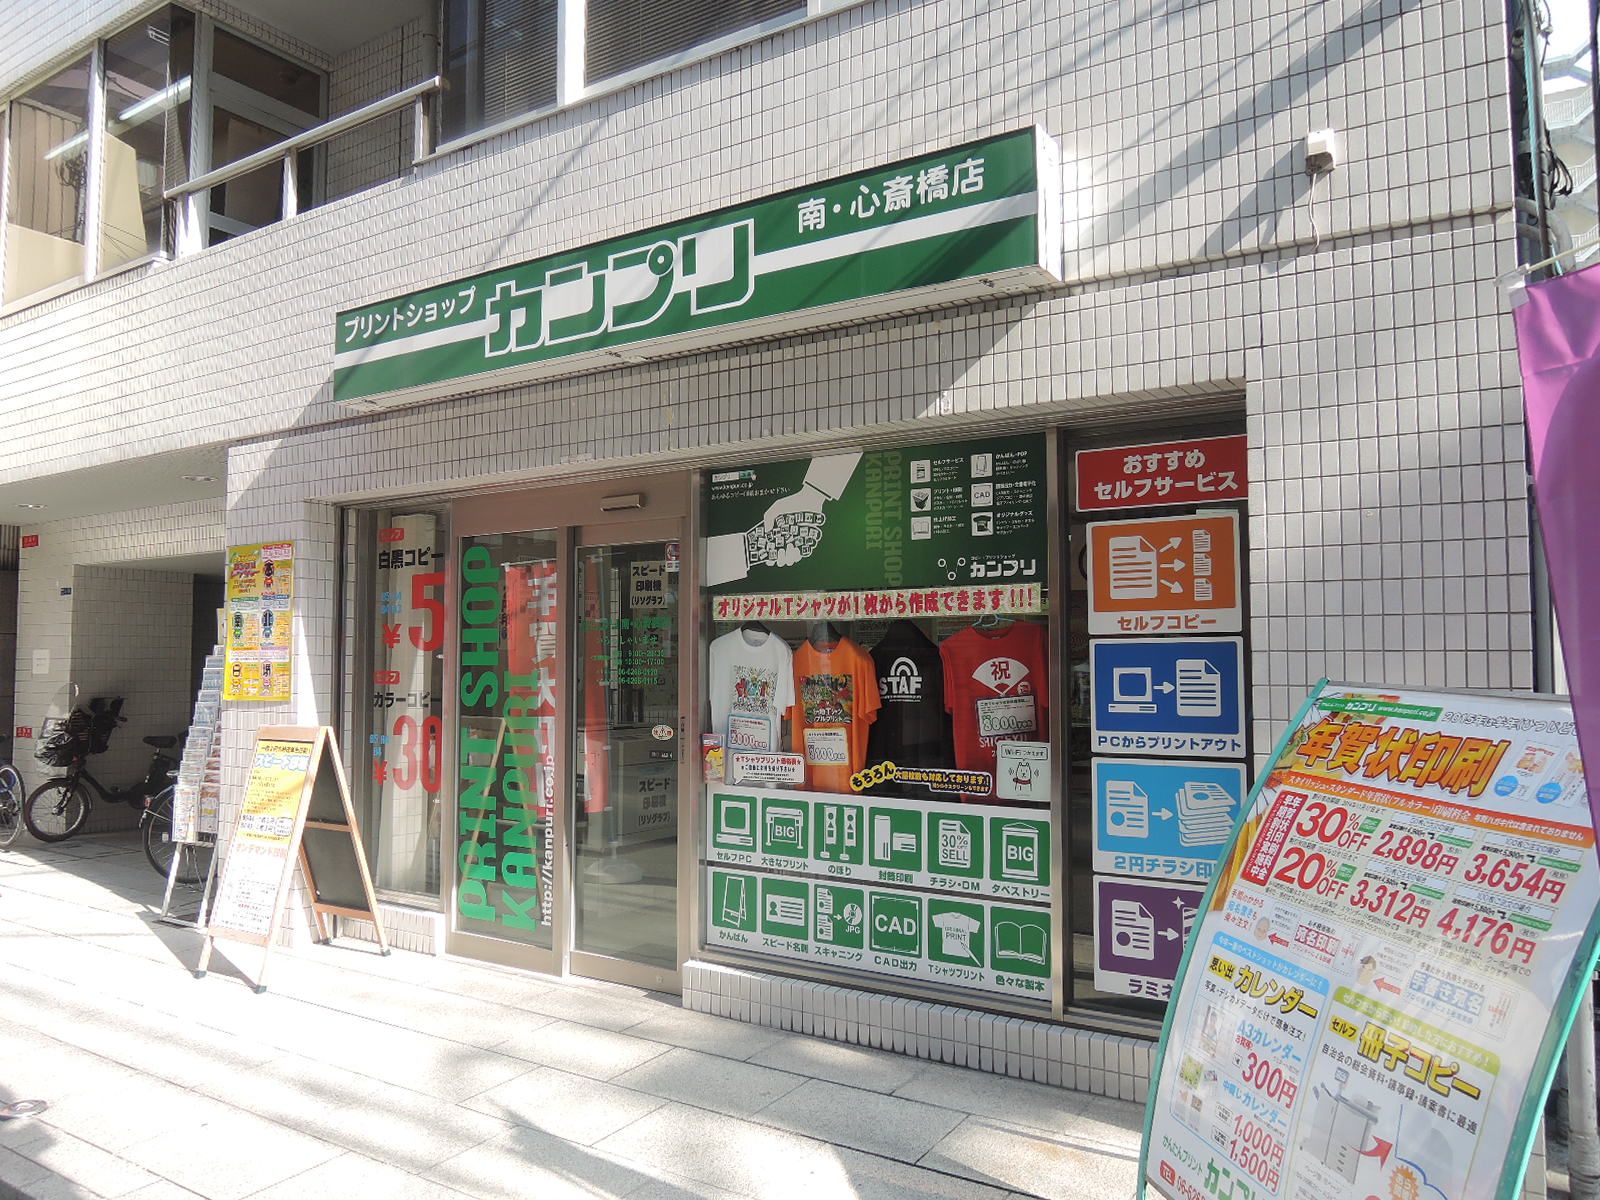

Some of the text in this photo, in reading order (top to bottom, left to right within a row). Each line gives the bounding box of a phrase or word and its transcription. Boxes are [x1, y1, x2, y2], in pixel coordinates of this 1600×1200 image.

[797, 158, 986, 234] 南・心斎橋店
[485, 218, 755, 358] カンプリ
[344, 286, 476, 344] プリントショップ
[1123, 449, 1206, 474] おすすめ
[974, 491, 991, 499] CAD
[1094, 471, 1239, 501] セルフサービス
[864, 453, 882, 550] KANPURI
[379, 547, 444, 569] 白黒コピー
[883, 526, 903, 587] SHOP
[632, 564, 666, 577] スピード
[970, 559, 1036, 578] カンプリ
[1117, 614, 1217, 632] セルフコピー
[990, 661, 1011, 681] 祝
[374, 692, 441, 708] カラーコピー
[458, 545, 500, 921] PRINT SHOP
[1098, 735, 1242, 752] PCからプリントアウト
[1296, 719, 1511, 797] 年賀状印刷
[851, 764, 895, 788] もちろん
[502, 670, 539, 931] KANPURI
[541, 754, 555, 926] http://kanpuri.co.jp
[775, 825, 795, 838] BIG
[1338, 830, 1372, 851] OFF
[717, 851, 752, 863] セルフPC
[942, 849, 969, 861] SELL
[1007, 845, 1034, 861] BIG
[1374, 830, 1460, 875] 2,898円
[1114, 855, 1216, 878] 2円チラシ印
[930, 877, 980, 891] チラシ・DM
[1317, 877, 1349, 899] OFF
[1464, 853, 1566, 904] 3,654円
[1350, 880, 1431, 928] 3,312円
[845, 925, 861, 934] JPG
[875, 914, 916, 936] CAD
[1437, 907, 1537, 964] 4,176円
[946, 932, 967, 941] PRINT
[815, 946, 863, 961] スキャニング
[875, 956, 917, 971] CAD出力
[928, 965, 985, 982] Tシャツプリント
[996, 975, 1046, 992] 色々な製本
[1234, 964, 1318, 1019] カレンダー
[1332, 1019, 1357, 1038] セルフ
[1358, 1021, 1482, 1100] 冊子コピー
[1242, 1052, 1298, 1109] 300円
[1234, 1114, 1286, 1168] 1,000円
[1230, 1140, 1281, 1193] 1,500円
